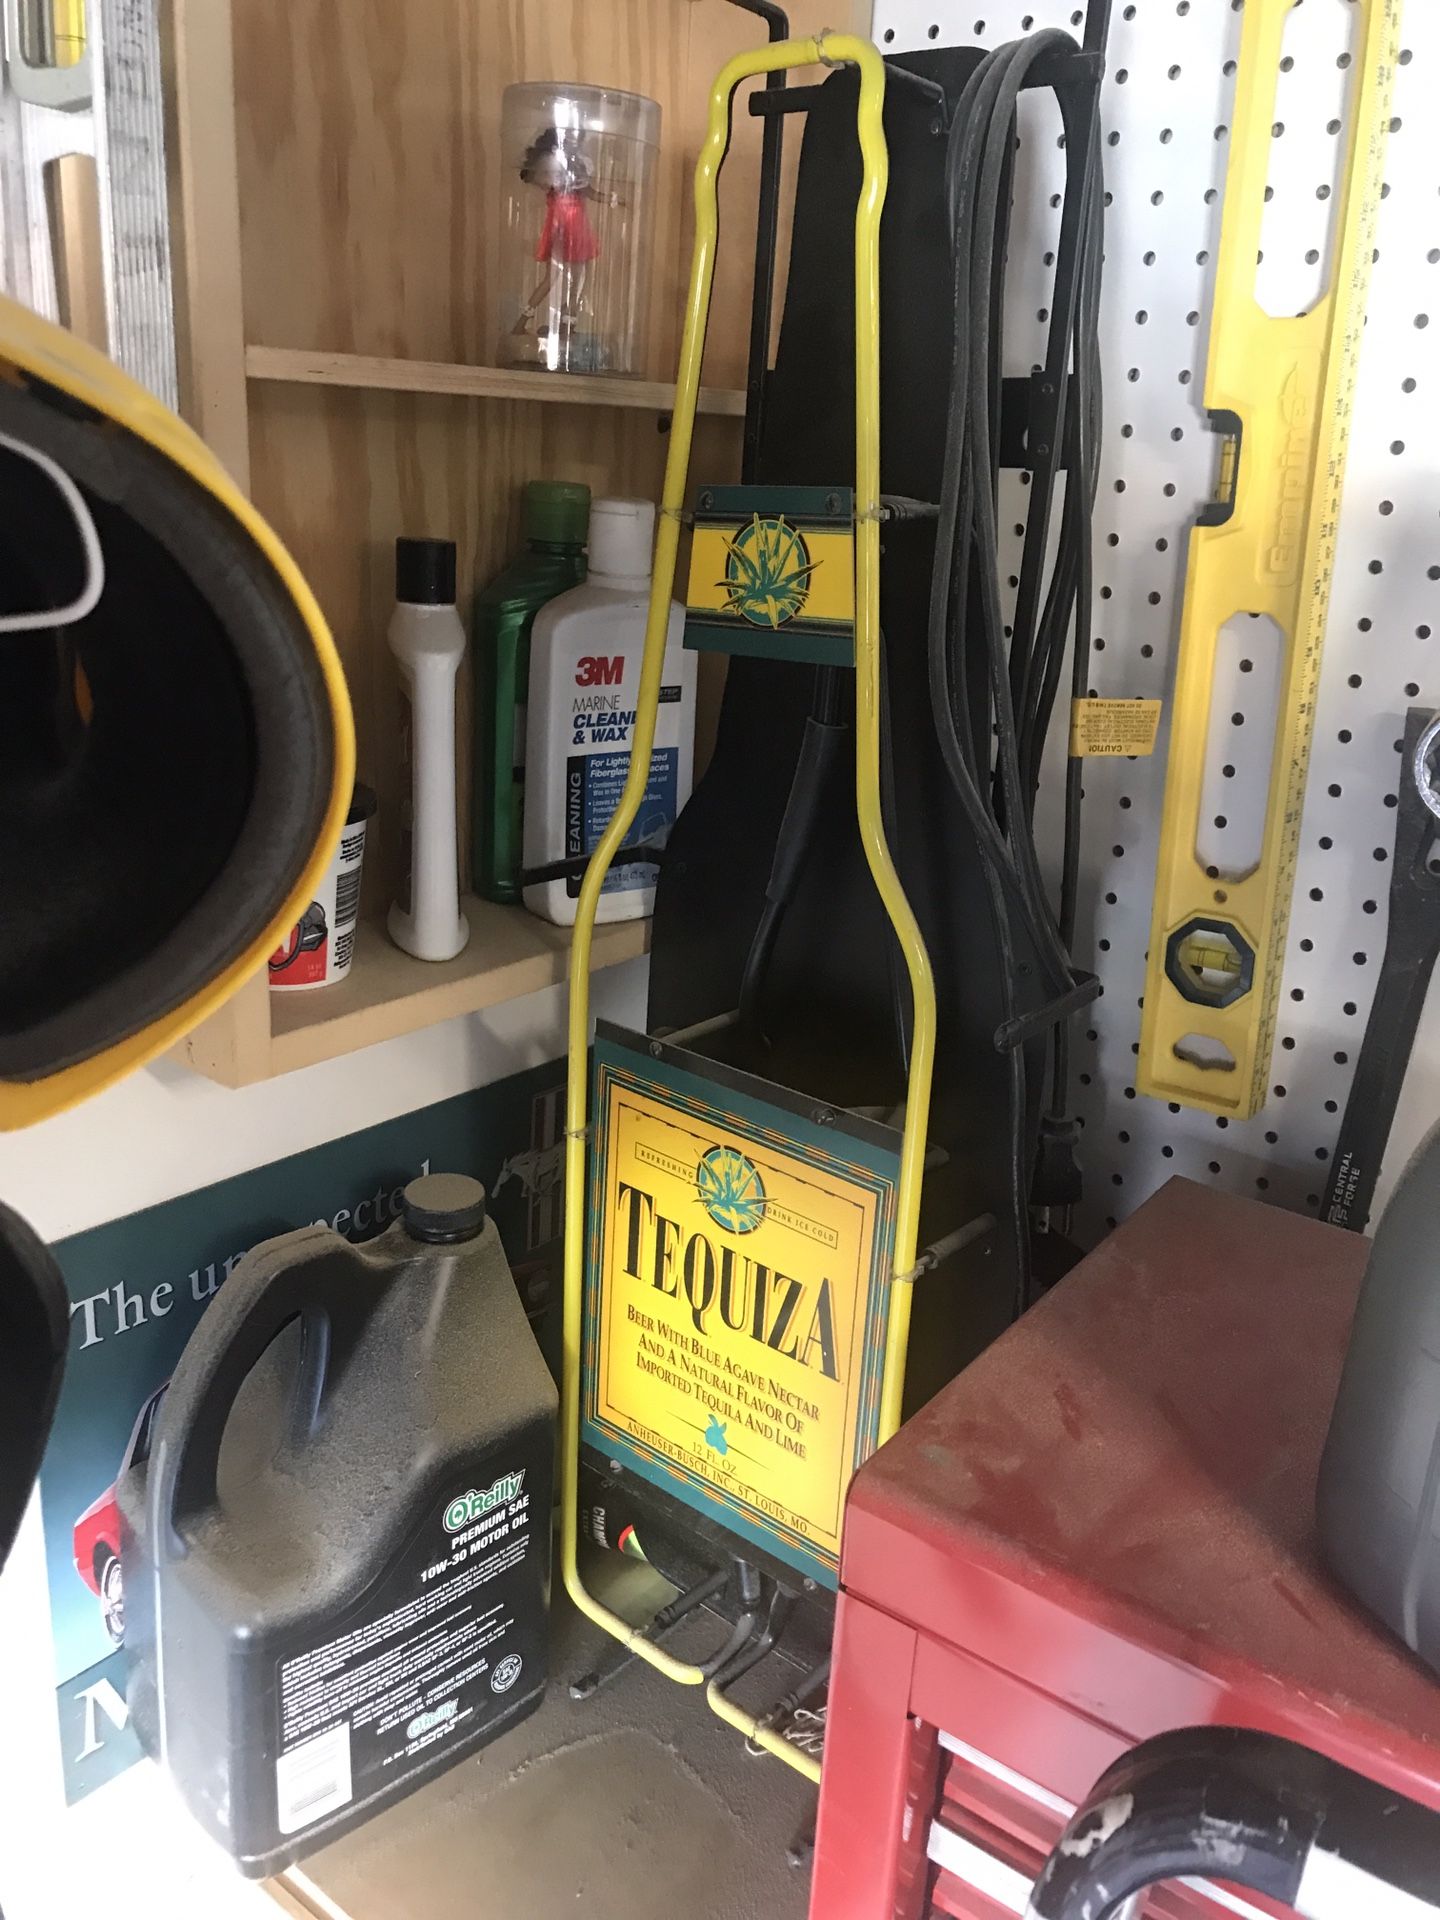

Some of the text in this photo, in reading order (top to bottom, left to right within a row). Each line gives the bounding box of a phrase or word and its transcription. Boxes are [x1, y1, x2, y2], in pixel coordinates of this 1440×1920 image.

[575, 655, 625, 687] 3M
[572, 695, 620, 712] MARINE
[573, 710, 637, 729] CLEAN
[572, 727, 629, 745] & WAX
[590, 759, 604, 768] For
[640, 1149, 694, 1179] REFRESHING
[1332, 1151, 1354, 1204] CENTRAL
[1343, 1167, 1361, 1208] FORGE
[767, 1205, 835, 1242] DRINK ICE COLD
[617, 1181, 842, 1383] TEQUIZA
[69, 1280, 174, 1350] The
[667, 1349, 677, 1366] A
[692, 1440, 703, 1455] 12
[443, 1470, 527, 1533] O'Reilly
[451, 1494, 530, 1550] PREMIUM SAE
[420, 1511, 530, 1583] 10W-30 MOTOR OIL
[398, 1696, 423, 1715] POLLUTE
